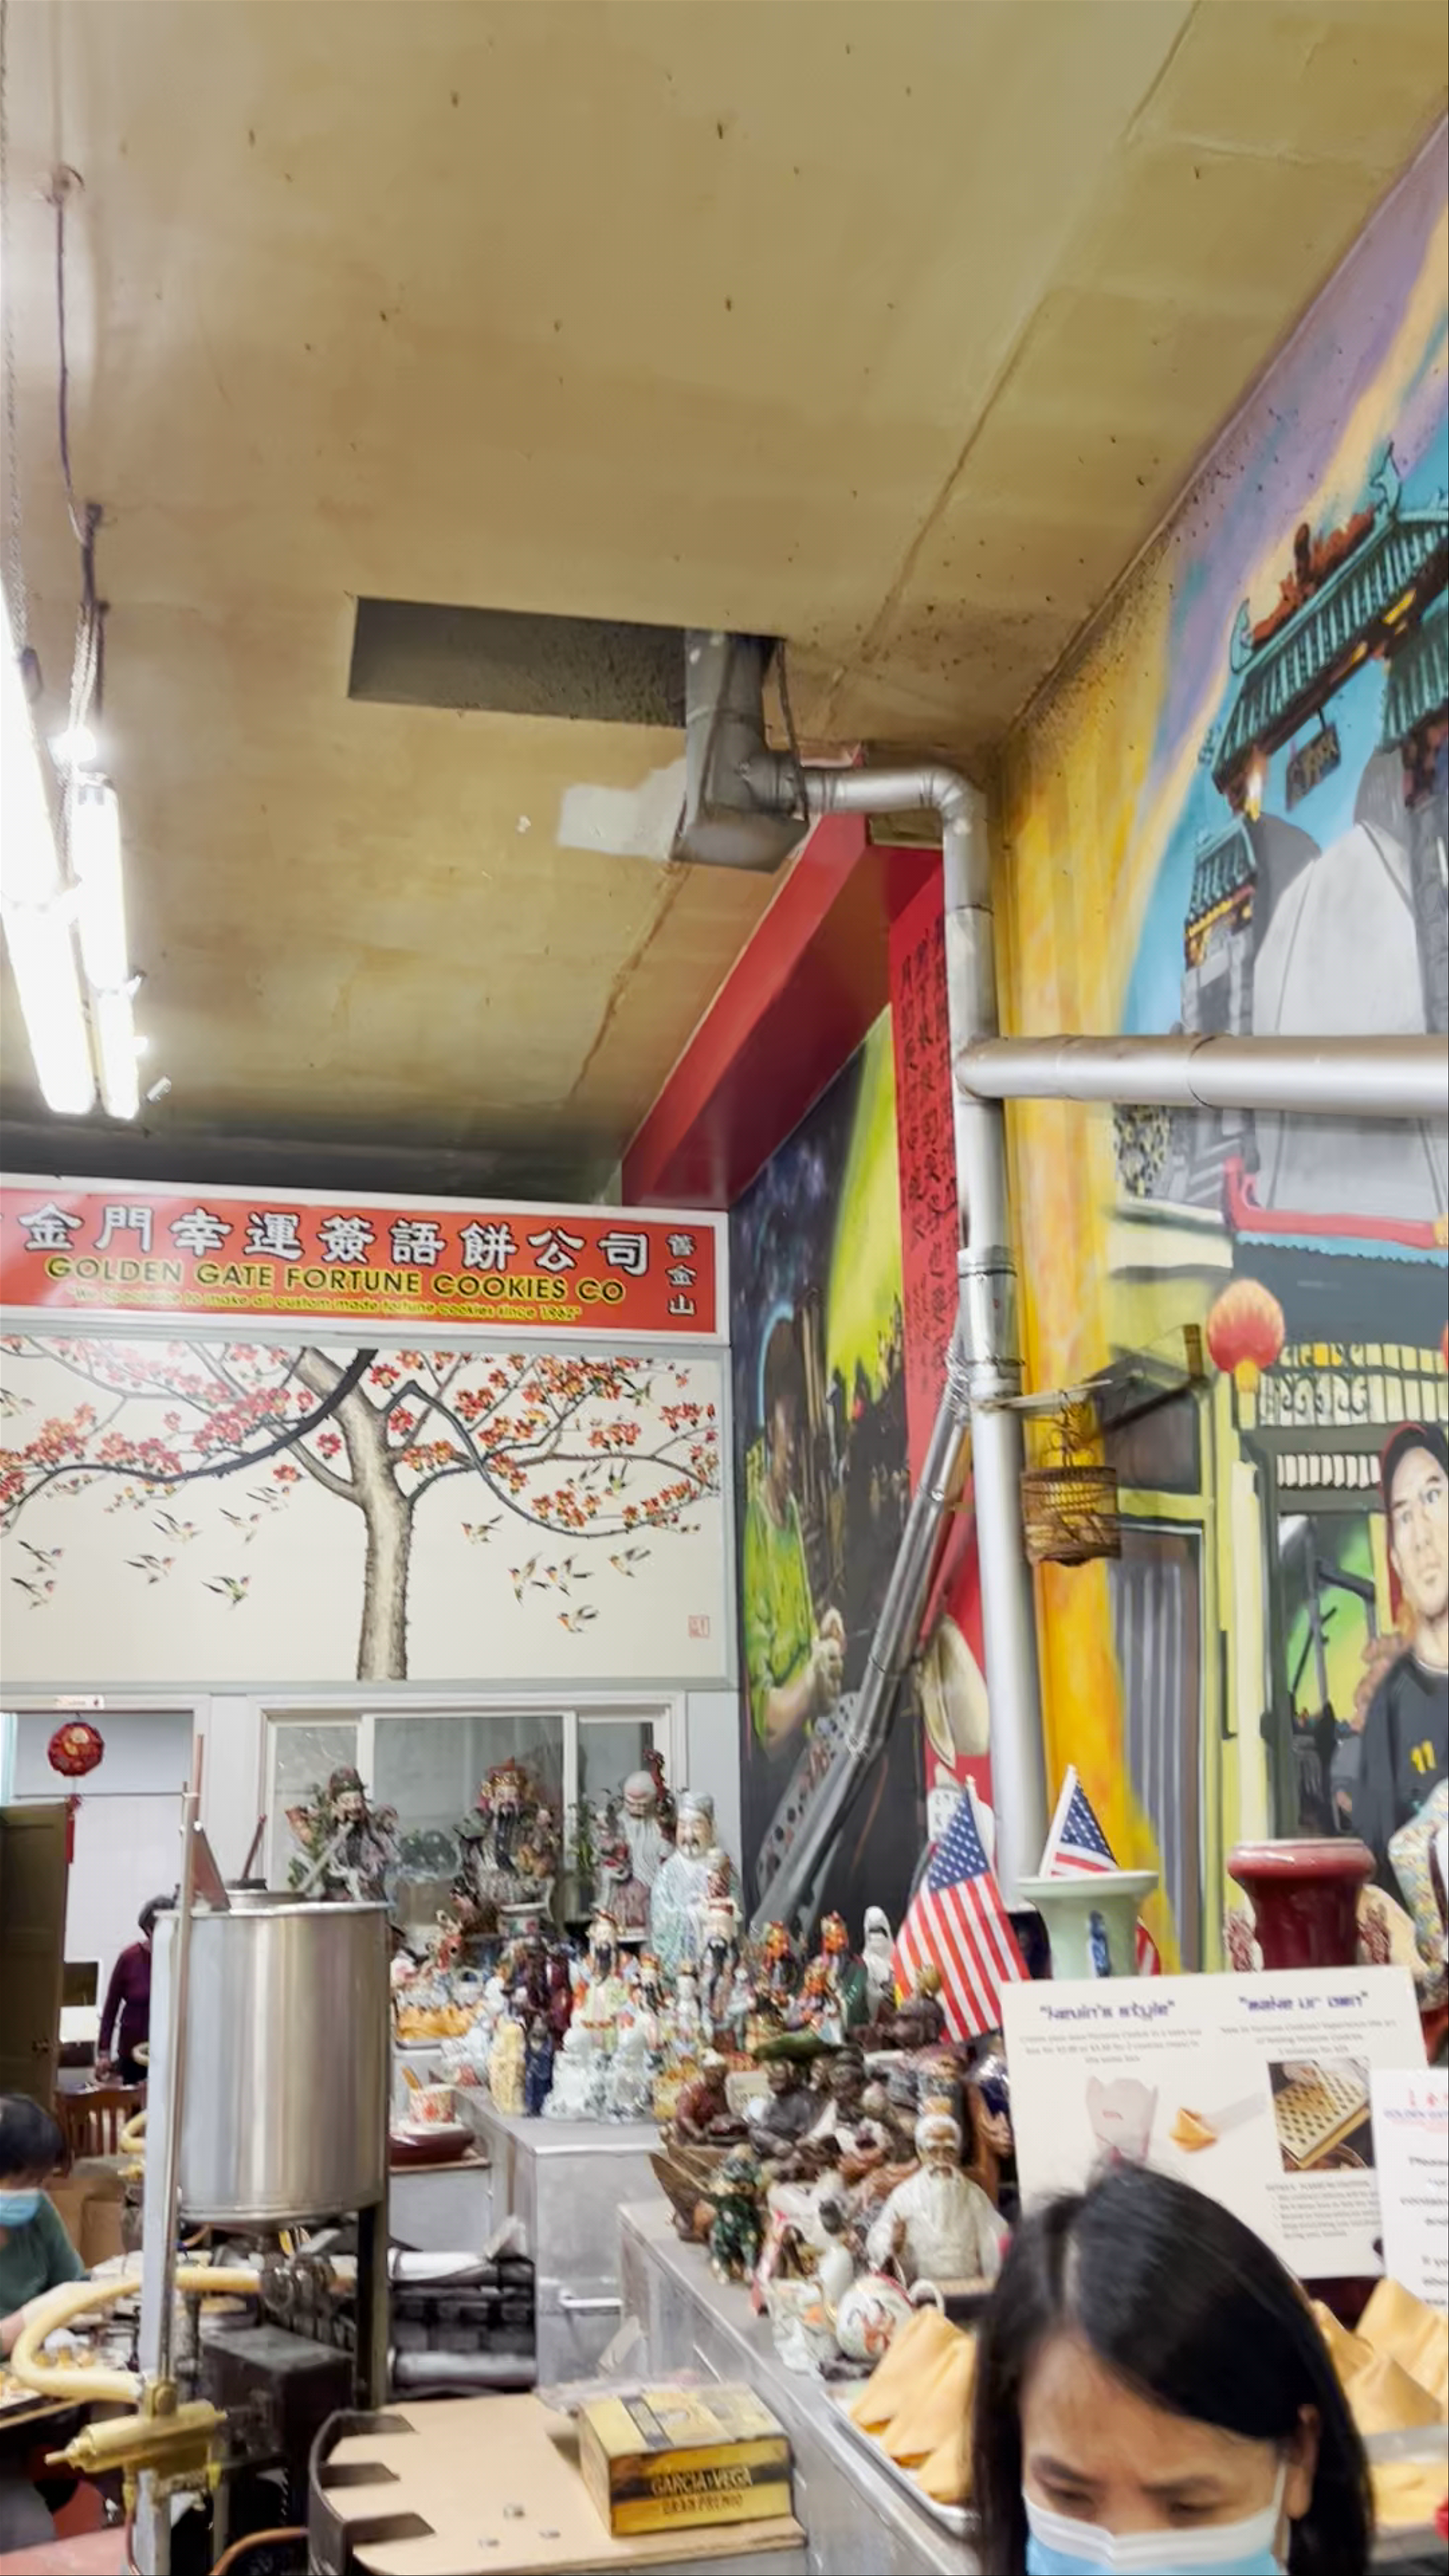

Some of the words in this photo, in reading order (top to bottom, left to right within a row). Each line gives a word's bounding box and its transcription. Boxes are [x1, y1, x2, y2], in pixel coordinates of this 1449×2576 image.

[18, 1203, 650, 1276] 金門幸運簽語餅公司
[47, 1256, 183, 1283] GOLDEN
[197, 1263, 273, 1287] GATE
[287, 1267, 420, 1293] FORTUNE
[434, 1273, 566, 1298] COOKIES
[578, 1280, 623, 1301] CO
[203, 1292, 248, 1306] make
[276, 1296, 331, 1309] custom
[334, 1297, 378, 1310] made
[381, 1300, 435, 1313] fortune
[437, 1303, 493, 1316] cookies
[497, 1305, 535, 1318] since
